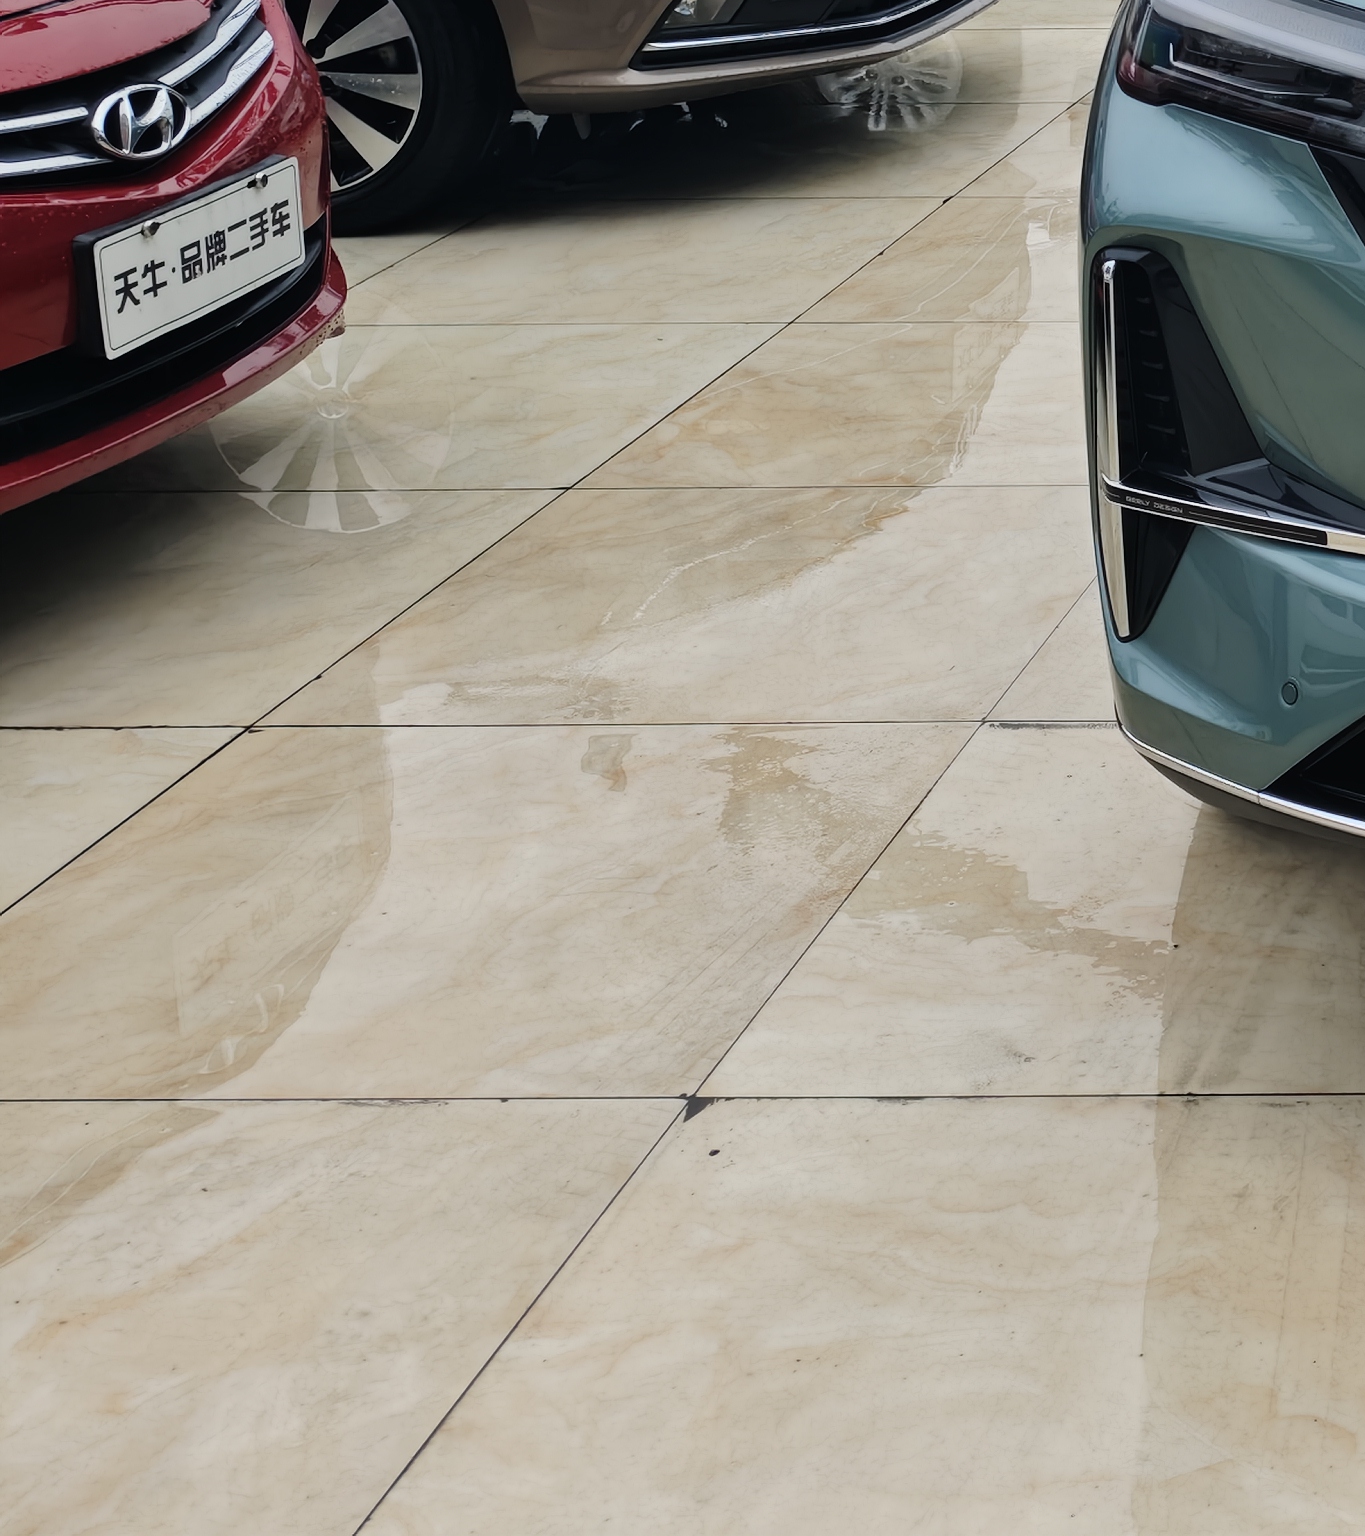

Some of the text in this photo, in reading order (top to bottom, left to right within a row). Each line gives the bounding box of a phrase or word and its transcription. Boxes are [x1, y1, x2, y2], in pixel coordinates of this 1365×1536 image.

[113, 199, 291, 314] 天牛·品牌二手车
[1125, 495, 1150, 507] GEELY
